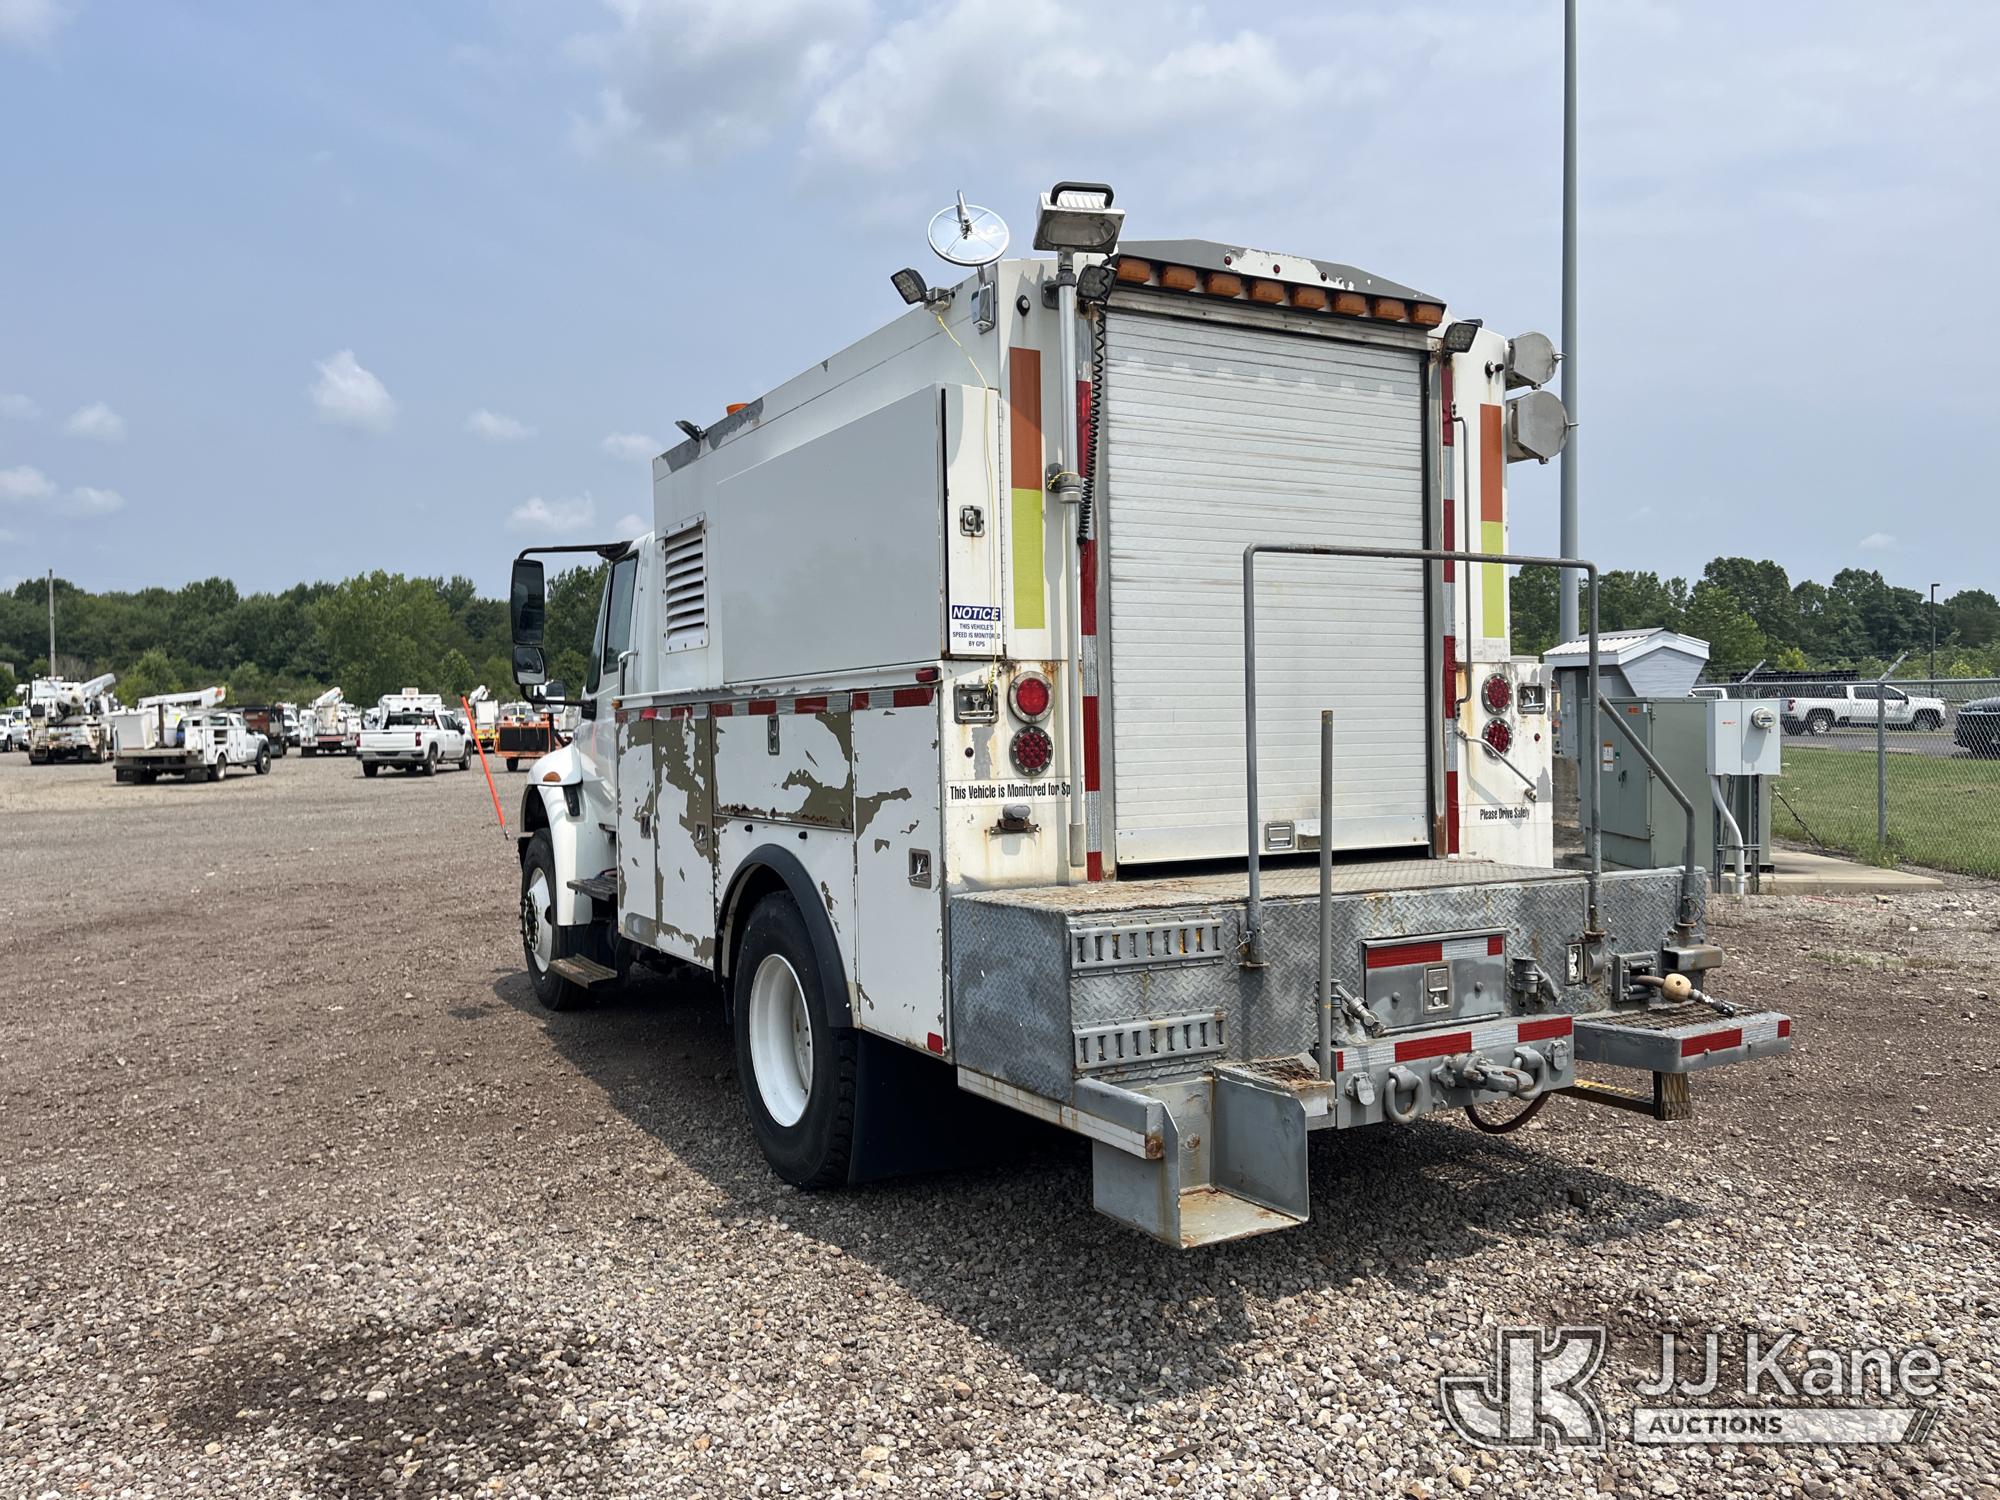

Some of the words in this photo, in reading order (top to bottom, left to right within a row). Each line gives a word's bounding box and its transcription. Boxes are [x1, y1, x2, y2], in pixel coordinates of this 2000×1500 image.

[953, 606, 999, 620] NOTICE
[975, 640, 986, 648] GPS
[950, 785, 966, 800] This
[968, 785, 996, 799] Vehicle
[998, 784, 1005, 798] is
[1007, 782, 1046, 798] Monitored
[1047, 782, 1059, 796] for
[1480, 809, 1497, 820] Please
[1499, 808, 1513, 819] Drive
[1514, 807, 1529, 820] Safely
